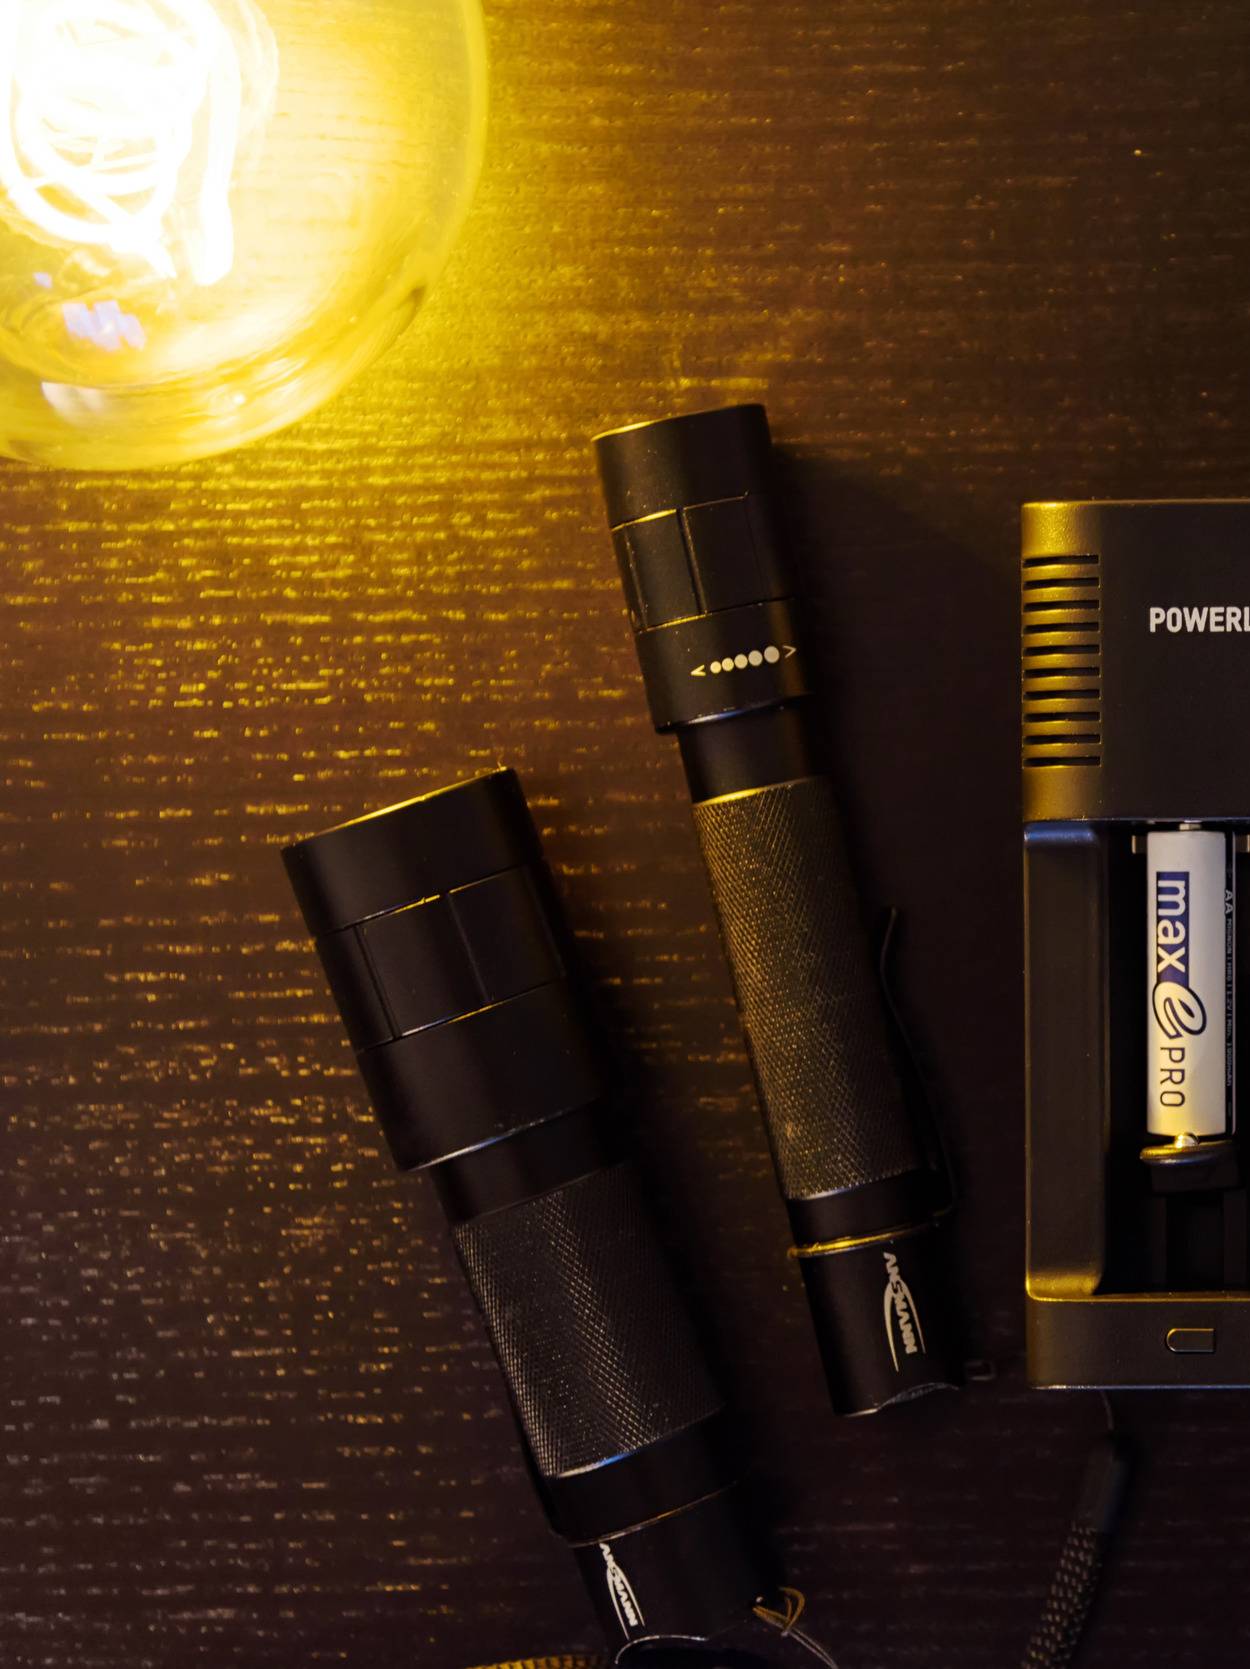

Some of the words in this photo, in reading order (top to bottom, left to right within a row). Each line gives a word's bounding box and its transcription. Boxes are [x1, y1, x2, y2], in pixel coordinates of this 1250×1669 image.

[1225, 889, 1233, 915] AA
[1159, 1046, 1186, 1108] PRO
[883, 1251, 918, 1354] ANSMANN
[599, 1543, 638, 1627] ANSMANN
